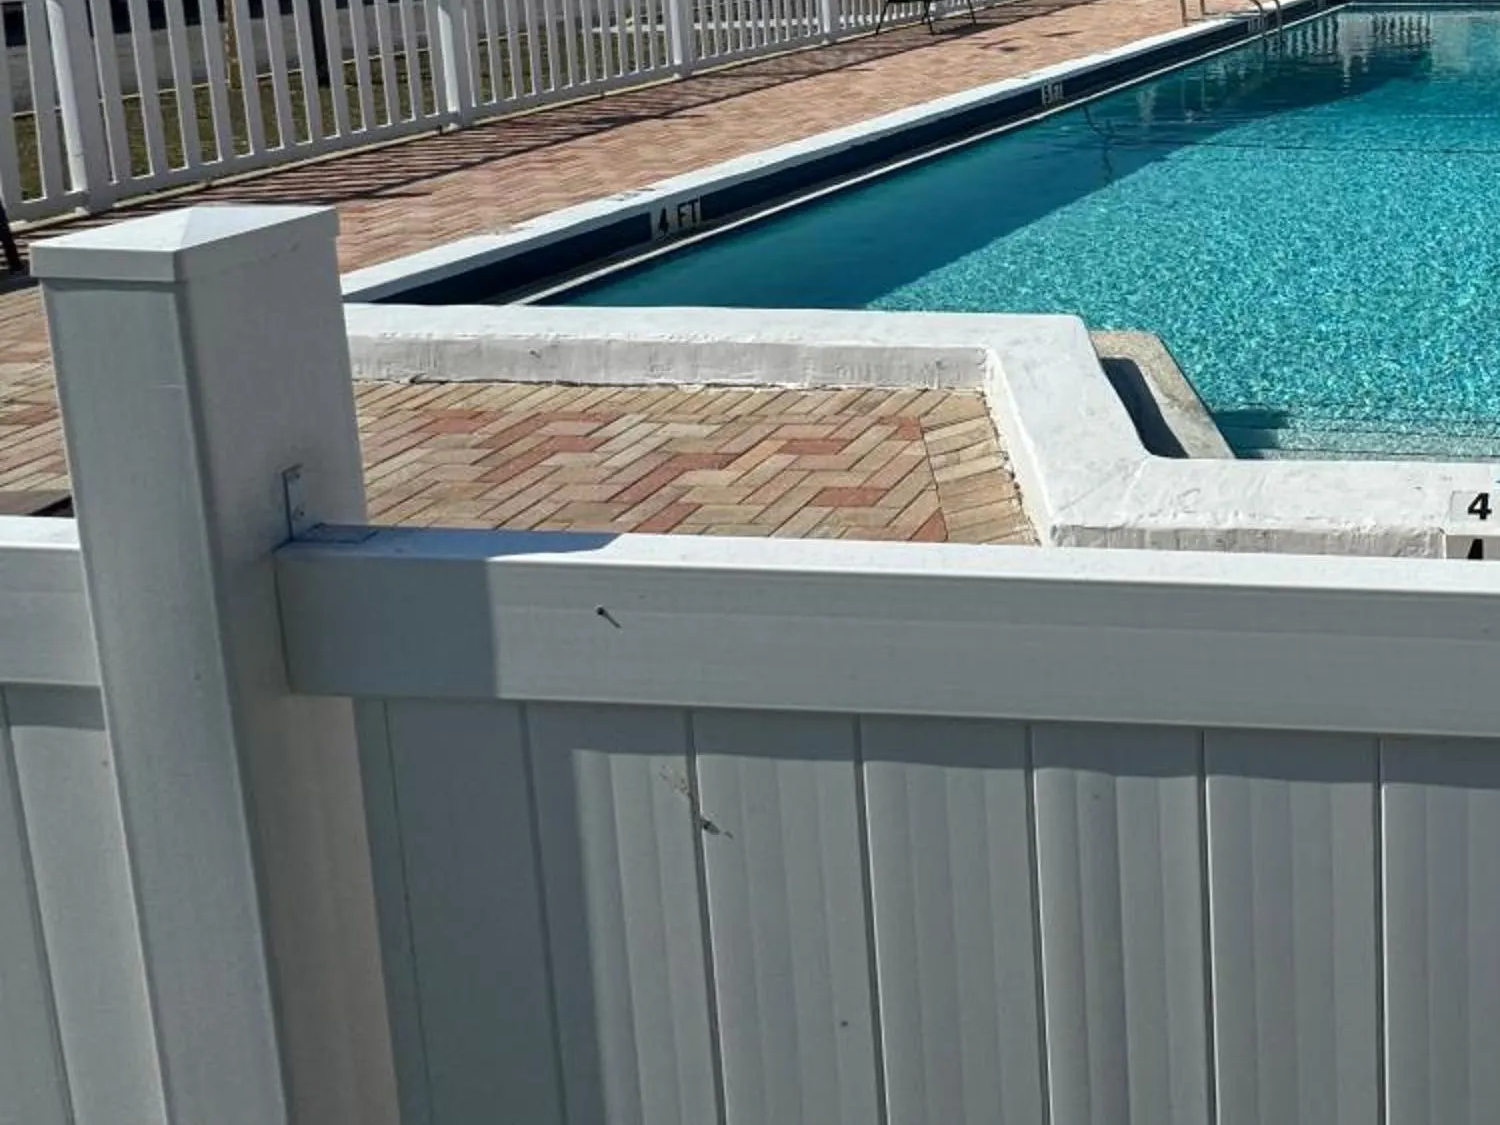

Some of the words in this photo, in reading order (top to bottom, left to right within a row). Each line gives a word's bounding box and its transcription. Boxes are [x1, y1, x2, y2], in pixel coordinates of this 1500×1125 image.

[658, 207, 669, 235] 4
[677, 197, 699, 227] FT
[1467, 492, 1492, 520] 4
